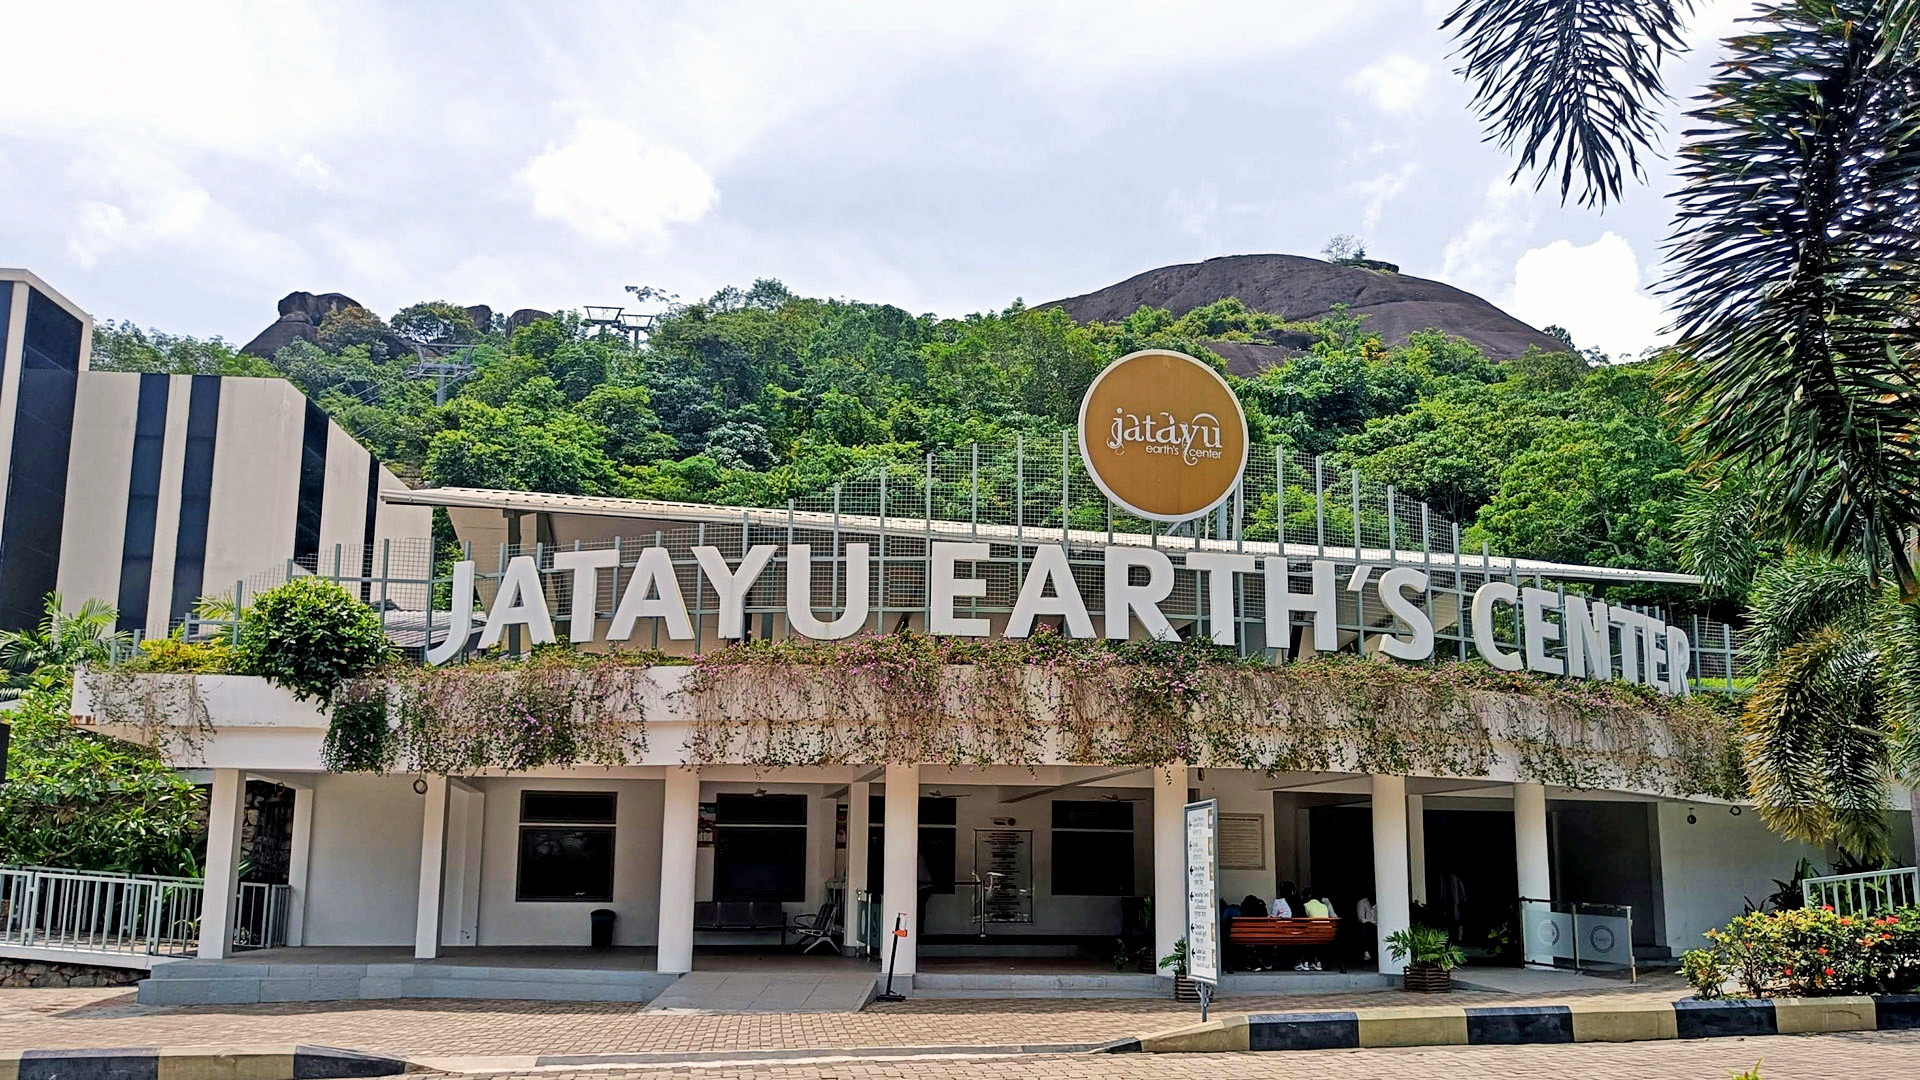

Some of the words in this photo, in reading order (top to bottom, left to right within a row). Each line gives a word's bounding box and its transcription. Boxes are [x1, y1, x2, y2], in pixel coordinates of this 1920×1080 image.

[1107, 408, 1223, 466] jatayu
[1145, 444, 1180, 456] earth's
[1189, 448, 1223, 460] center
[426, 543, 870, 667] JATAYU
[930, 541, 1435, 661] EARTH'S
[1471, 581, 1691, 697] CENTER
